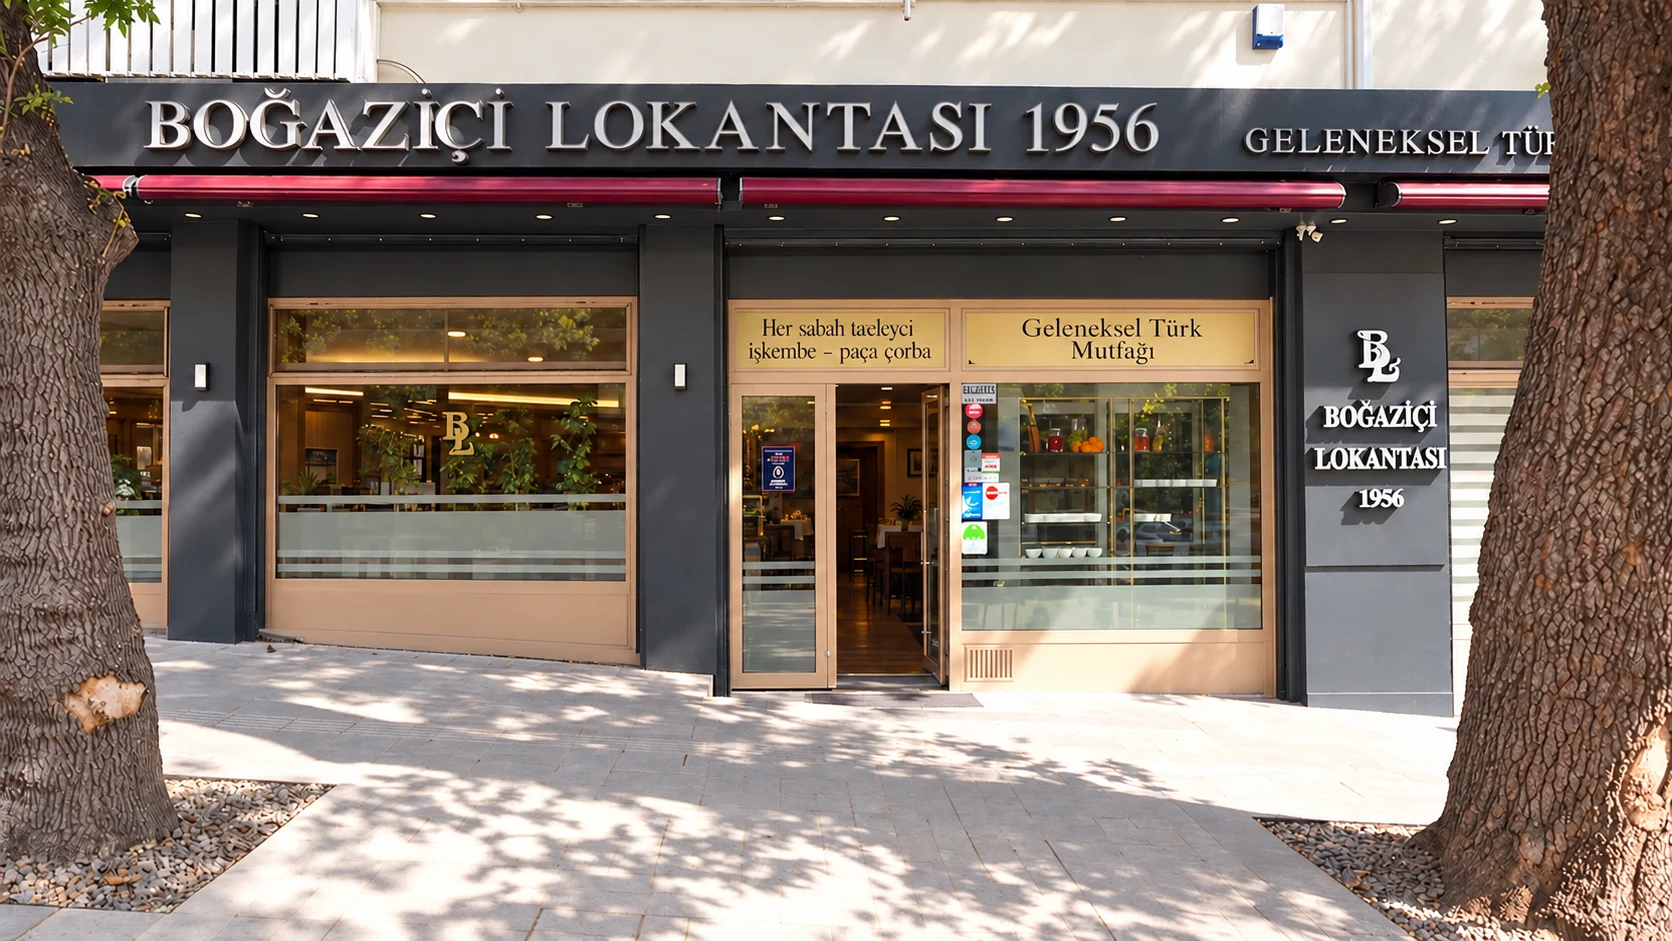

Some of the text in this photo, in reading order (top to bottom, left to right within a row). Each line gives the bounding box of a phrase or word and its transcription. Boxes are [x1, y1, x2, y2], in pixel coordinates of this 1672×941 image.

[143, 86, 1160, 165] BOĞAZİÇİ LOKANTASI 1956
[1244, 126, 1491, 156] GELENEKSEL
[762, 318, 793, 337] Her
[799, 318, 845, 337] sabah
[1021, 317, 1203, 338] Geleneksel Türk
[748, 341, 817, 364] işkembe
[839, 345, 879, 365] paça
[884, 341, 932, 364] çorba
[1070, 340, 1156, 365] Mutfağı
[1322, 399, 1438, 433] BOĞAZİÇİ
[1314, 446, 1448, 470] LOKANTASI
[1358, 487, 1405, 508] 1956
